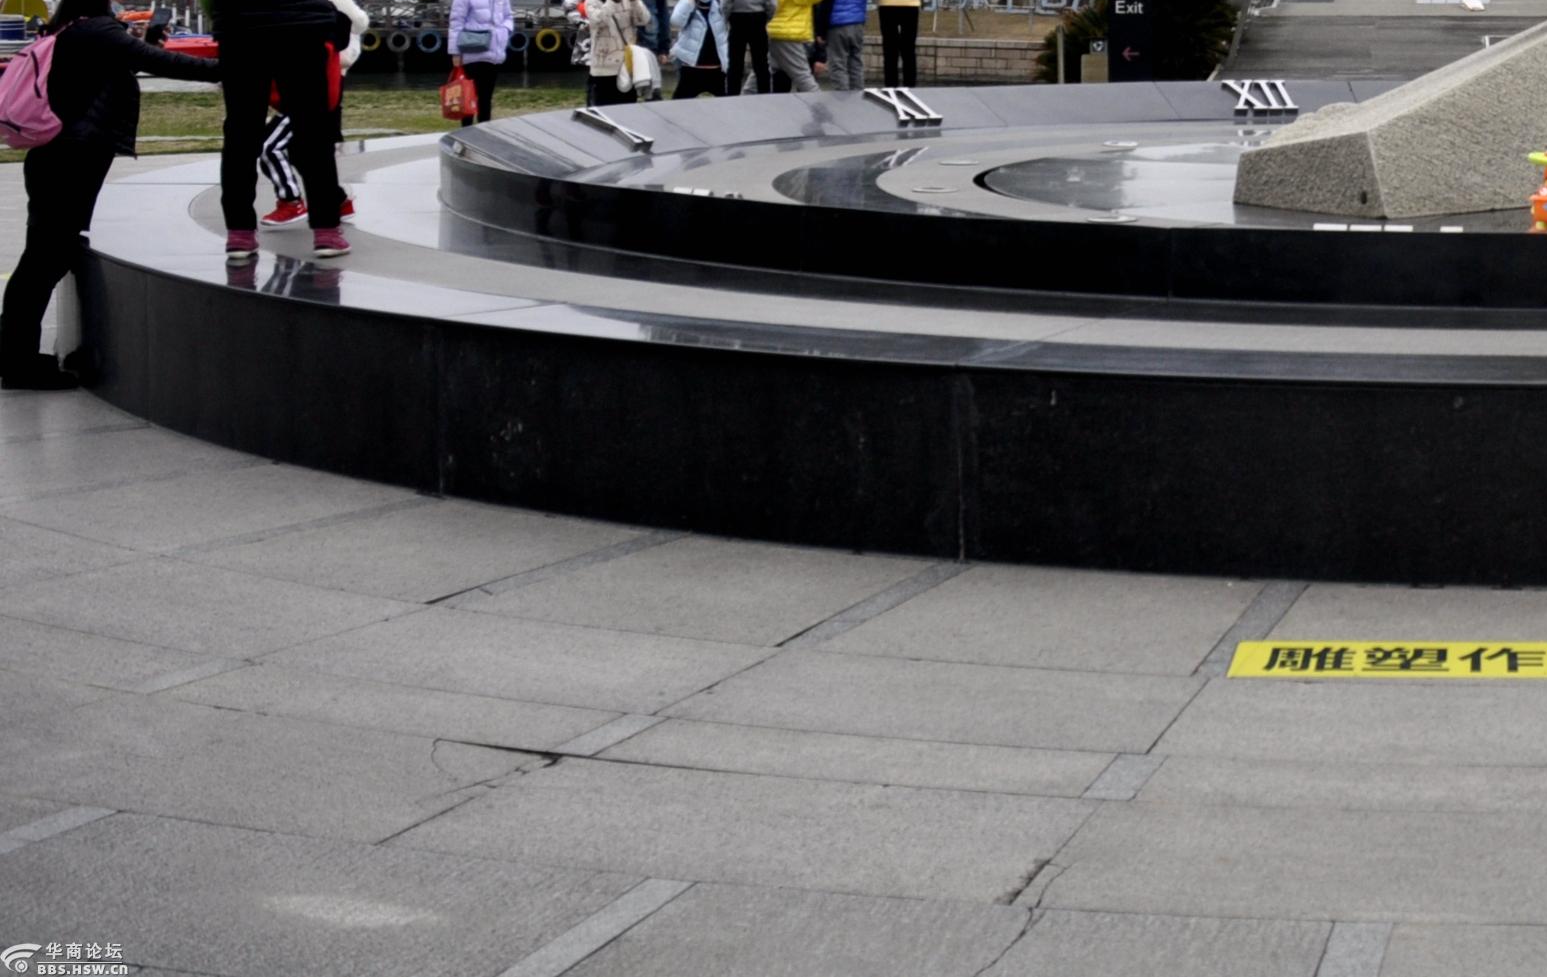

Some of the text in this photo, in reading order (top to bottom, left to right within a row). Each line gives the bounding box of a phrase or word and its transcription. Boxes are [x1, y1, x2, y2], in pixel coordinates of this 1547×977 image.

[1115, 0, 1144, 14] Exit
[863, 87, 943, 121] XI
[1221, 79, 1299, 111] XII
